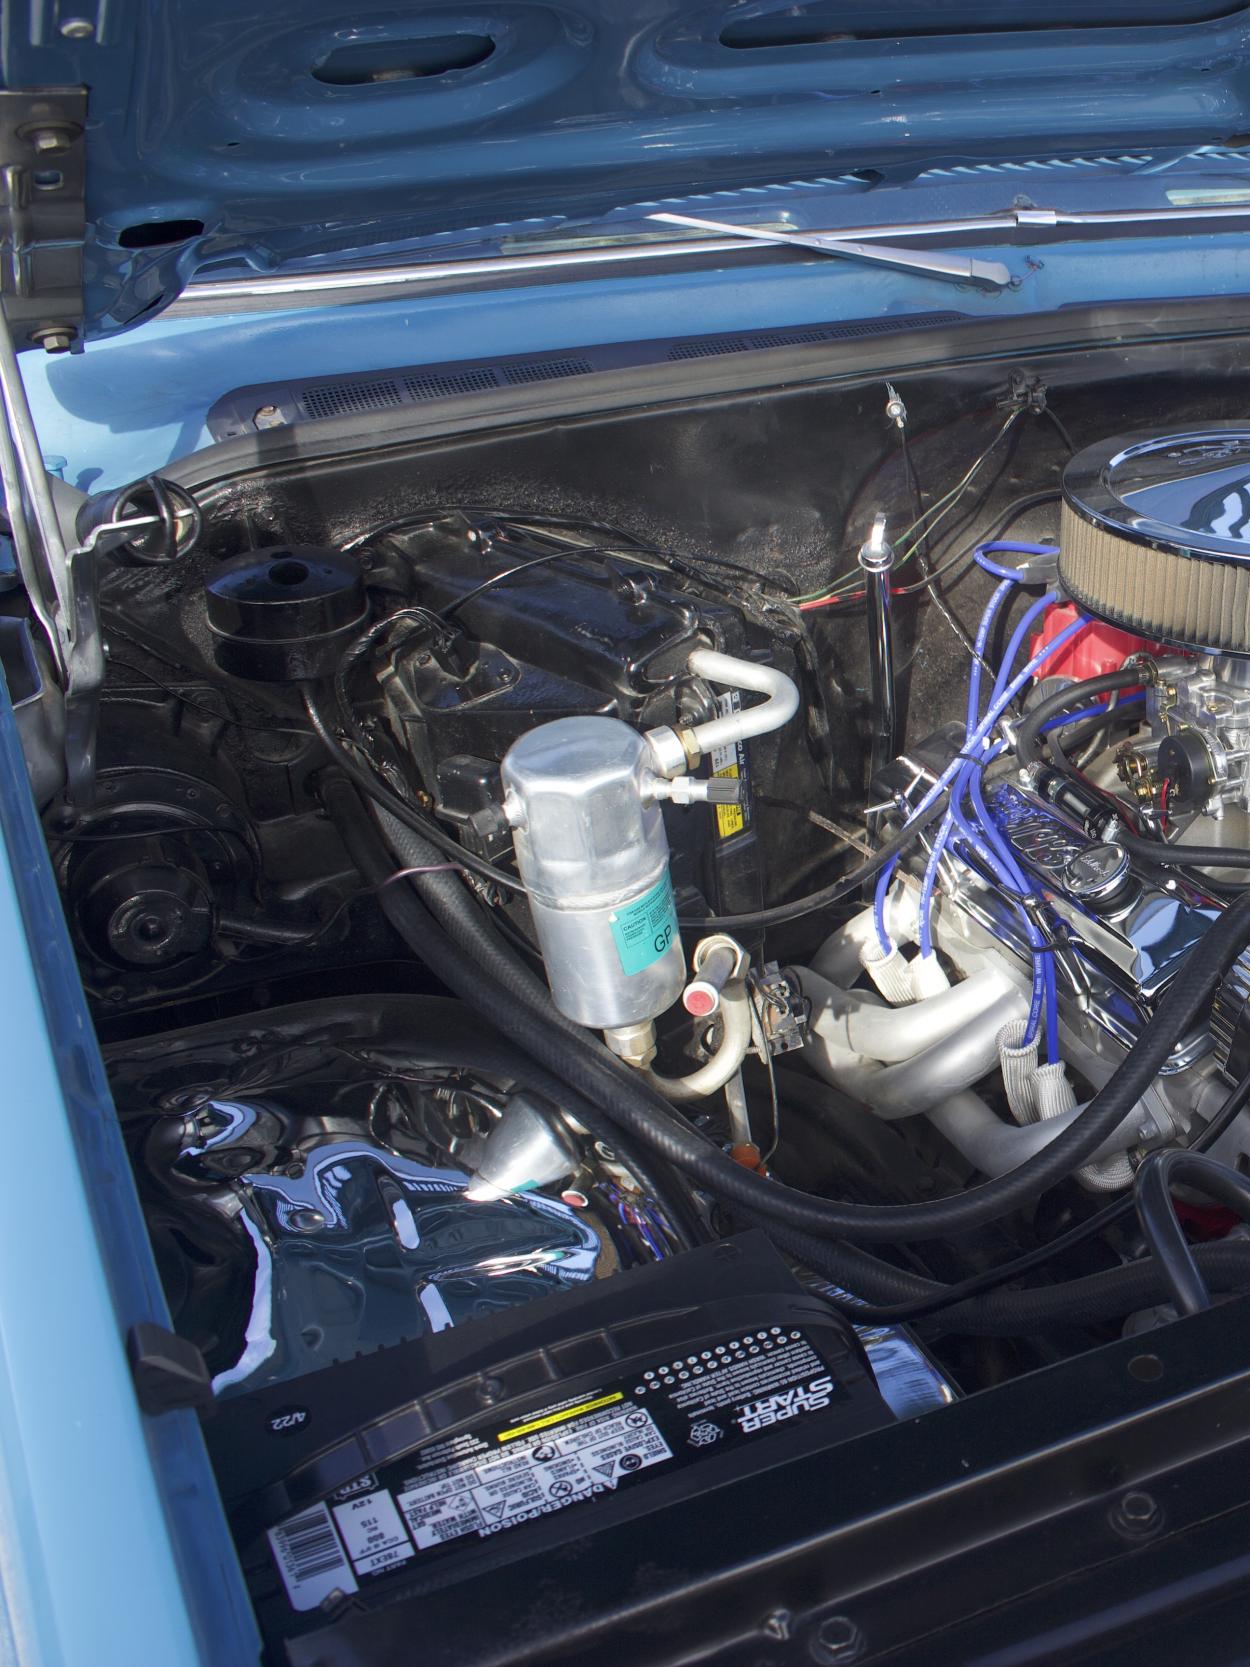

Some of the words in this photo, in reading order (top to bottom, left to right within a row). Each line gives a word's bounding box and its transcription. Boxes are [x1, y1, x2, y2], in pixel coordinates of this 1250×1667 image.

[654, 924, 672, 953] GP
[1034, 955, 1042, 975] WIRE
[1032, 1000, 1041, 1018] CORE
[737, 1376, 833, 1423] START
[271, 1412, 306, 1430] 4/22
[741, 1396, 830, 1433] SUPER
[622, 1434, 660, 1452] EXPLOSIVE
[599, 1447, 623, 1460] GASES
[642, 1446, 667, 1460] SHIELD
[350, 1497, 372, 1510] 12V
[477, 1483, 604, 1537] DANGER/POISON
[507, 1494, 542, 1511] SULFURIC
[359, 1516, 378, 1528] 115
[408, 1507, 442, 1524] MEDICAL
[430, 1514, 480, 1537] IMMEDIATELY
[439, 1528, 458, 1540] EYES
[459, 1520, 483, 1533] FLUSH
[368, 1550, 399, 1566] 78EXT
